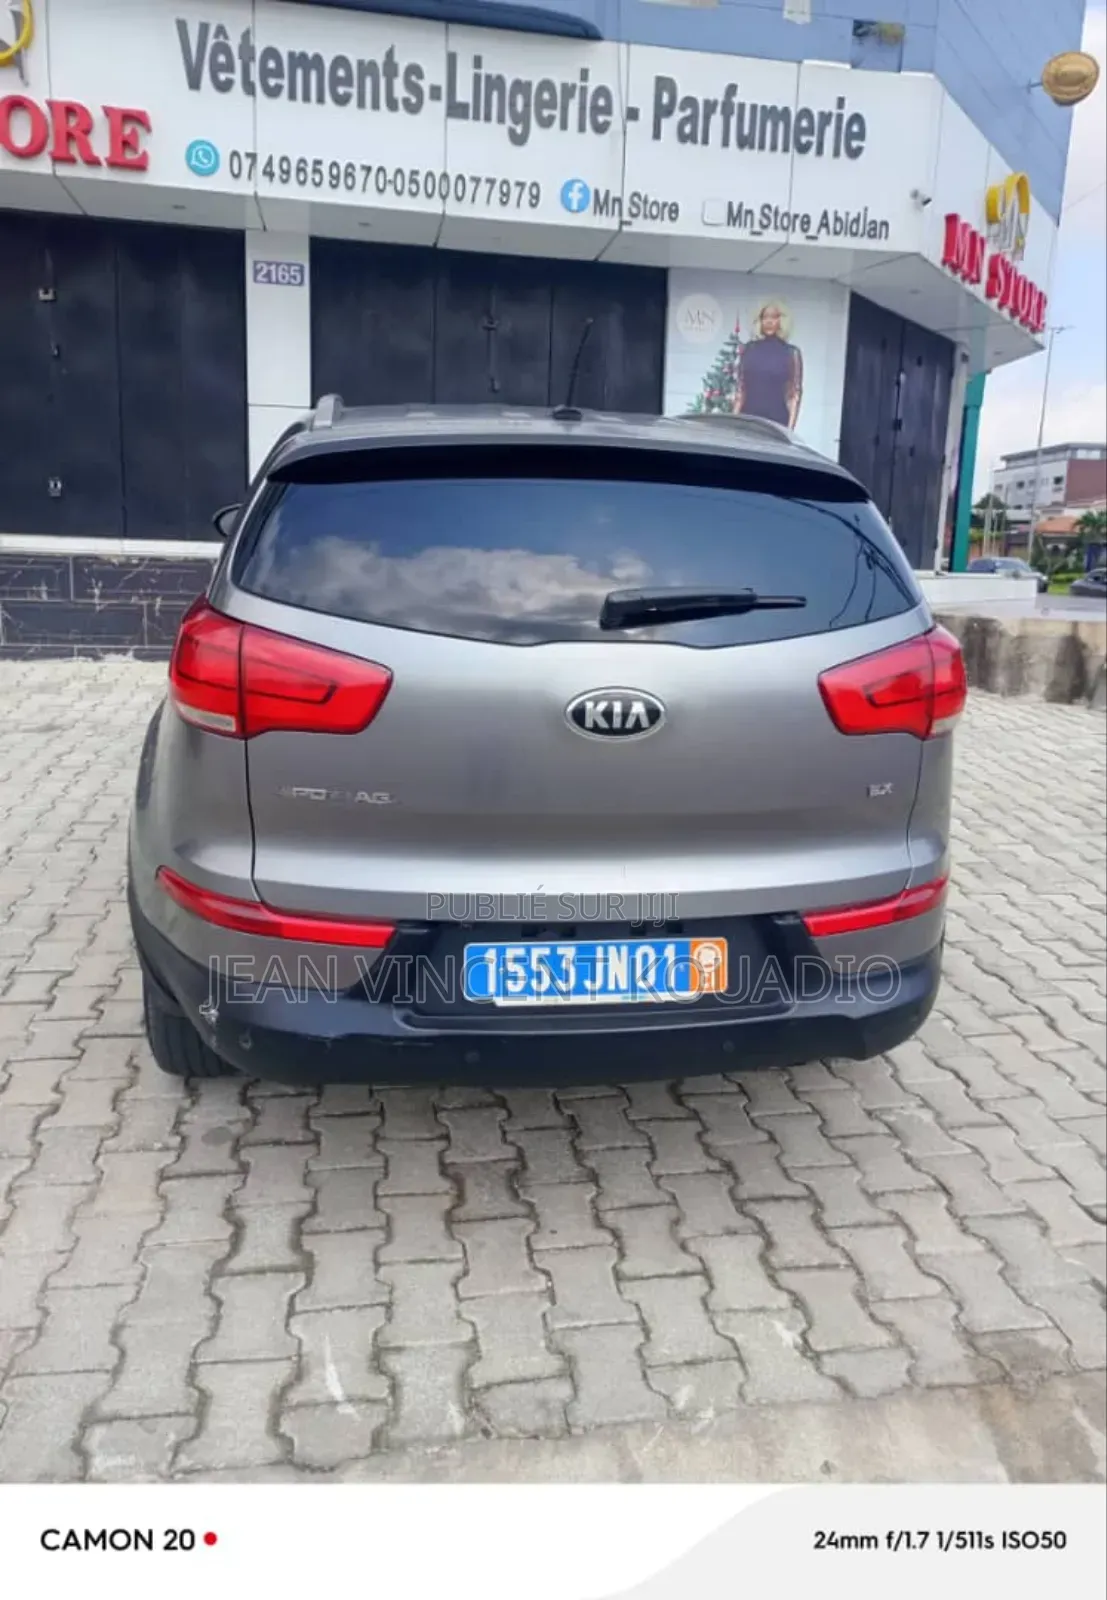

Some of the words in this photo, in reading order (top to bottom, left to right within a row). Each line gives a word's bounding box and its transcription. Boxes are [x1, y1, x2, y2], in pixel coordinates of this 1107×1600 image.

[0, 94, 152, 172] ORE
[652, 75, 867, 160] Parfumerie
[229, 150, 541, 209] 0749659670-0500077979
[593, 187, 680, 226] Mn_Store
[255, 262, 301, 285] 2165
[584, 700, 650, 729] KIA
